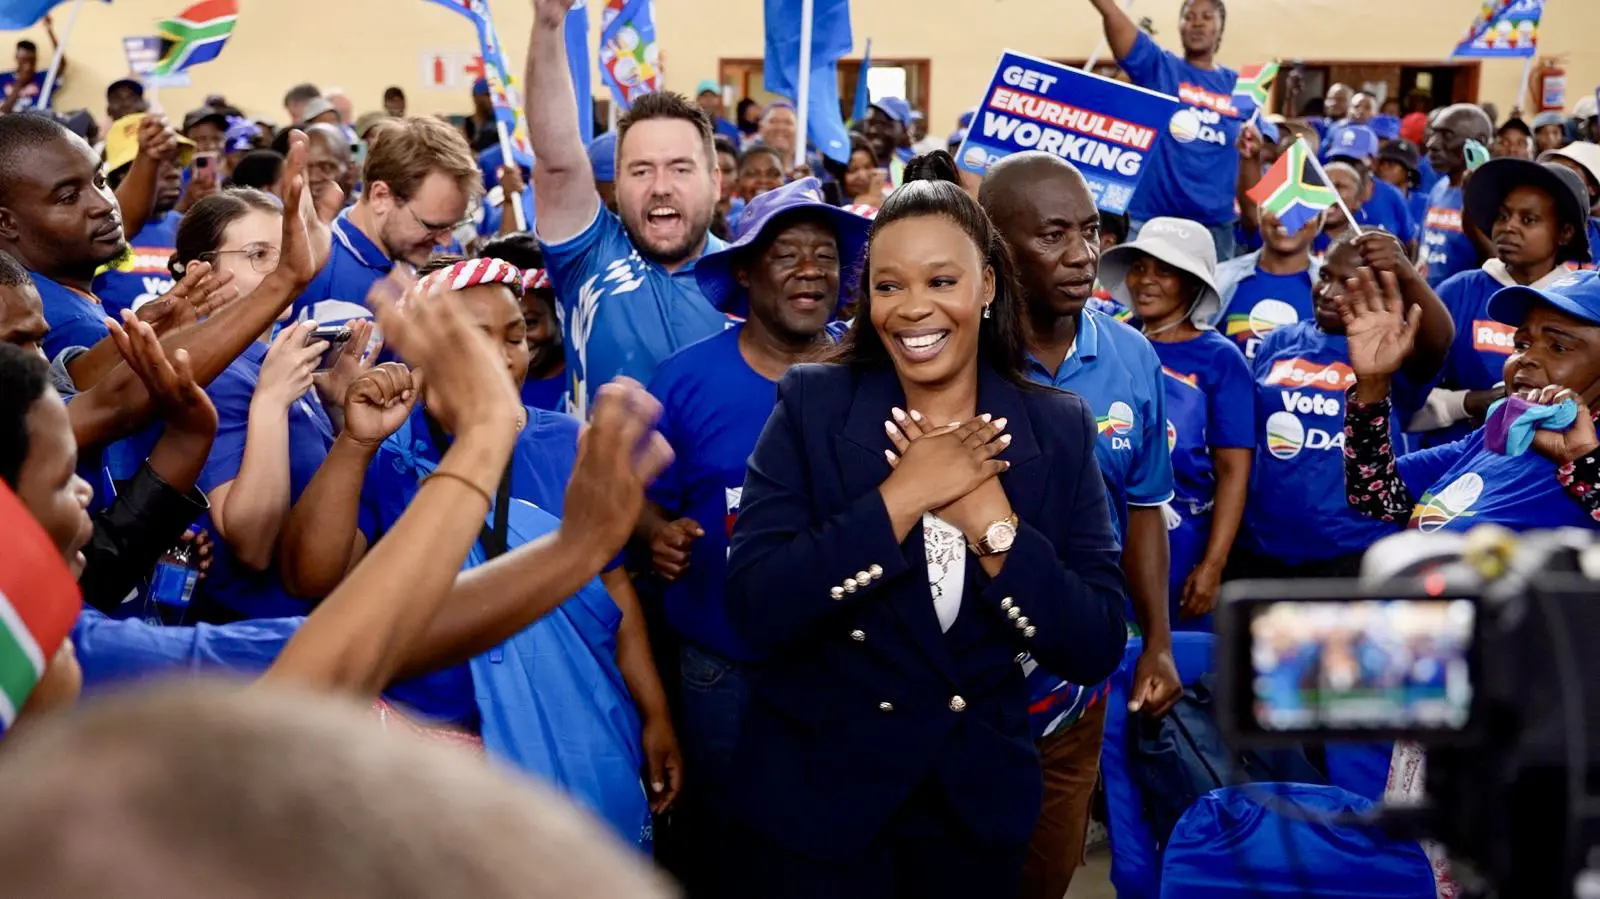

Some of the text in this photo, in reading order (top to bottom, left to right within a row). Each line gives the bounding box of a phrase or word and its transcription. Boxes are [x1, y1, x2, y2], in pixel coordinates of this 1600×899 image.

[1002, 66, 1057, 94] GET
[989, 90, 1156, 148] EKURHULENI
[982, 112, 1143, 176] WORKING
[1281, 390, 1340, 416] Vote
[1111, 437, 1132, 450] DA
[1304, 428, 1346, 451] DA
